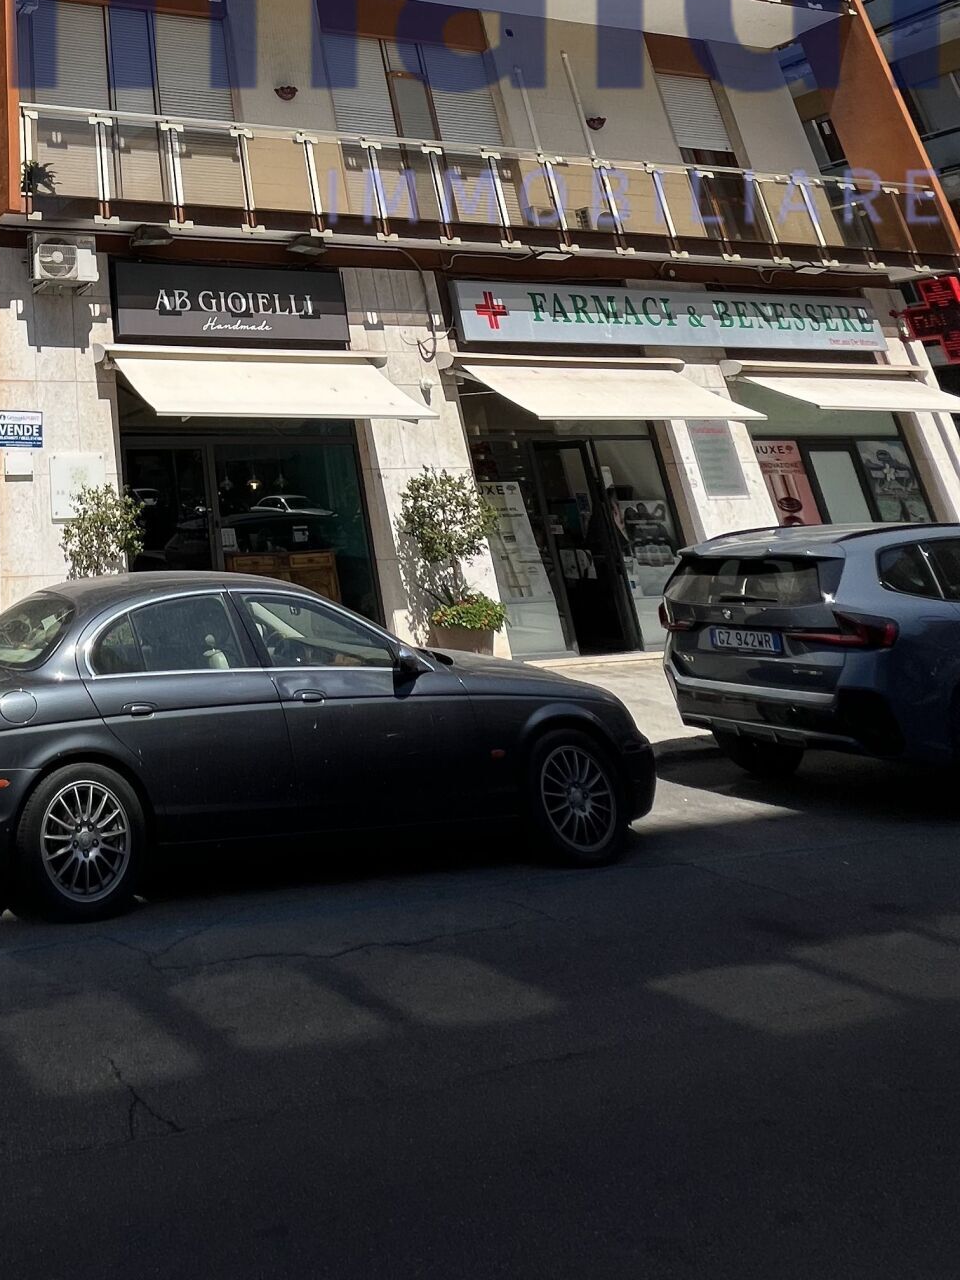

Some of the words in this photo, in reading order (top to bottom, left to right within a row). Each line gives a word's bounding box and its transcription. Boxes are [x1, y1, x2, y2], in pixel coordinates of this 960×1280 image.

[155, 289, 191, 311] AB
[198, 291, 314, 316] GIOIELLI
[527, 292, 677, 327] FARMACI
[686, 305, 707, 328] &
[712, 300, 875, 333] BENESSERE
[202, 317, 272, 331] Handmade
[718, 631, 732, 645] GZ
[735, 632, 772, 648] 942WR
